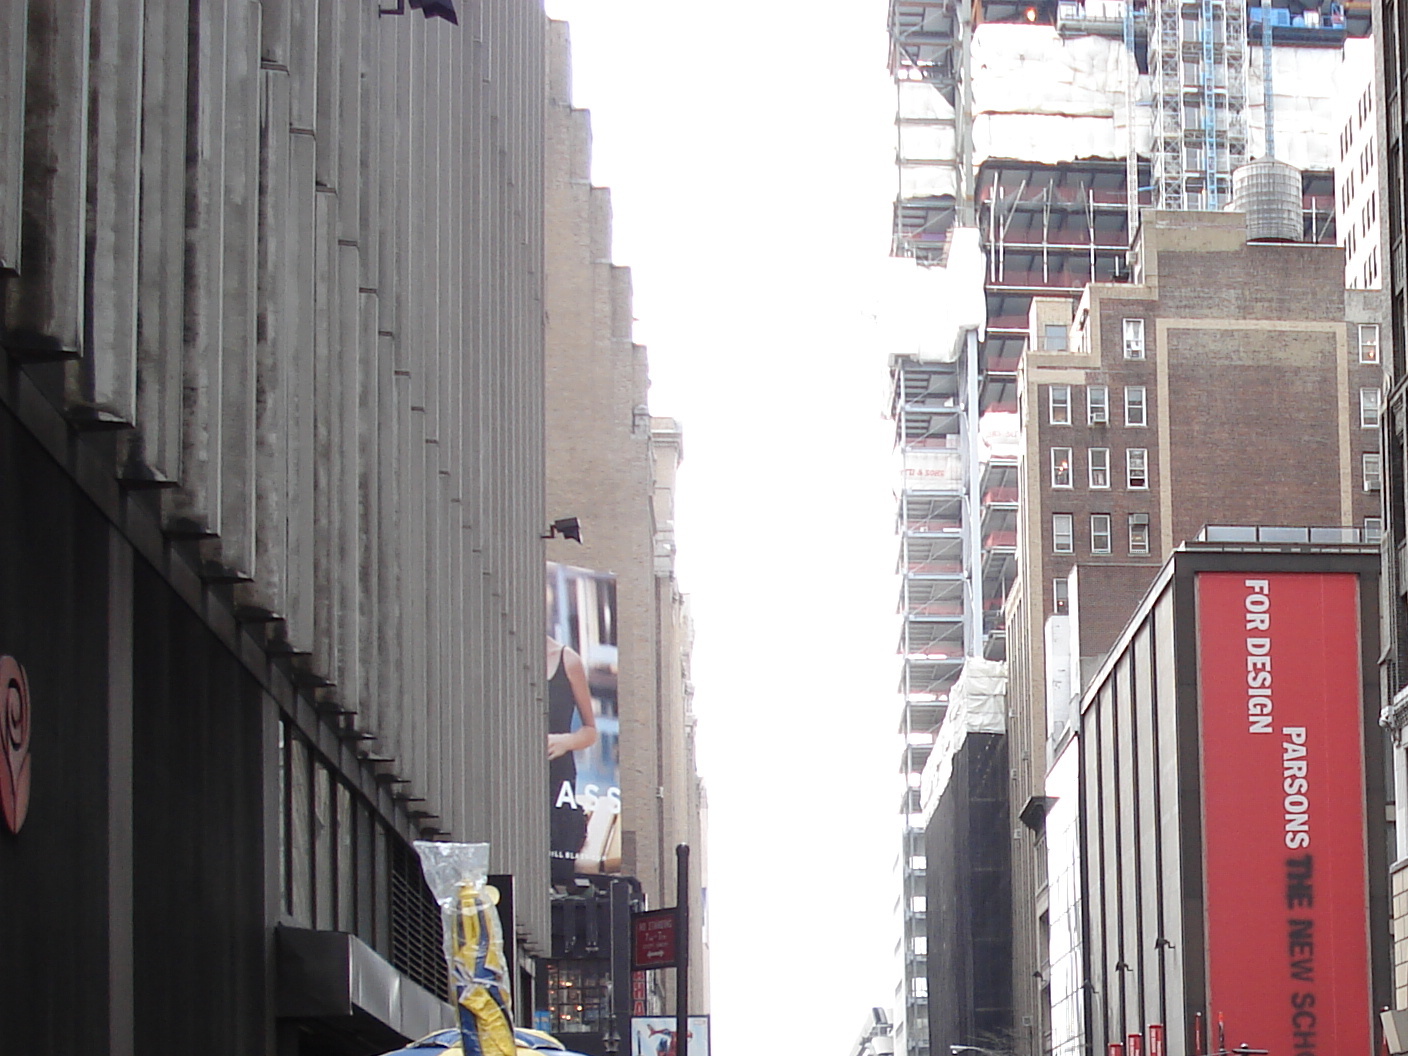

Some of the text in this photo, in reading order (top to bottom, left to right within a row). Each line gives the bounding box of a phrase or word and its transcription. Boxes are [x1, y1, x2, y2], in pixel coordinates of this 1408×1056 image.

[1245, 580, 1273, 733] FOR DESIGN
[1282, 726, 1310, 849] PARSONS
[1285, 855, 1314, 910] THE
[1288, 918, 1314, 982] NEW
